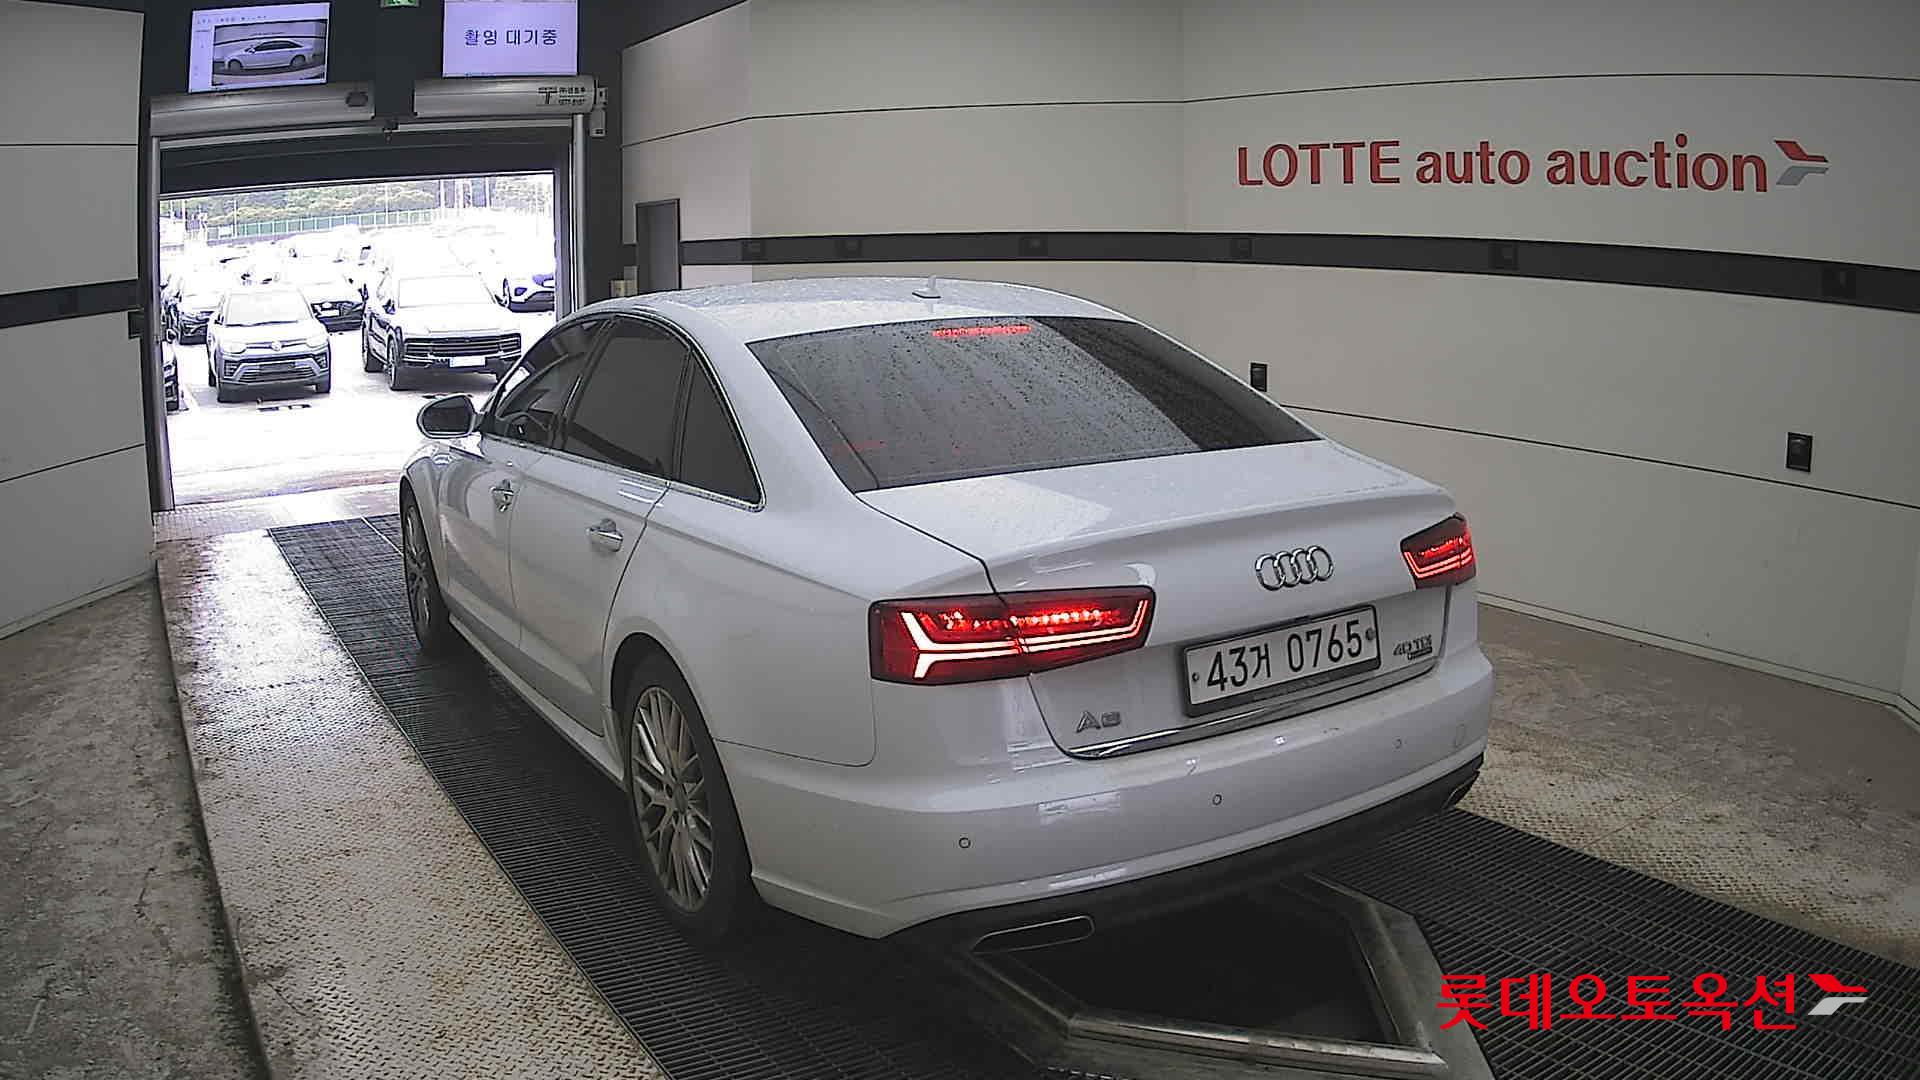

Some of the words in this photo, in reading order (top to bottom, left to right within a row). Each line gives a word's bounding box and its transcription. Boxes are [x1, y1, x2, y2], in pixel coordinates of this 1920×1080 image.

[464, 29, 498, 46] 촬영
[505, 29, 558, 46] 대기중
[1237, 140, 1400, 187] LOTTE
[1415, 141, 1530, 185] auto
[1546, 134, 1768, 193] auction
[1206, 644, 1272, 692] 43거
[1287, 619, 1363, 673] 0765
